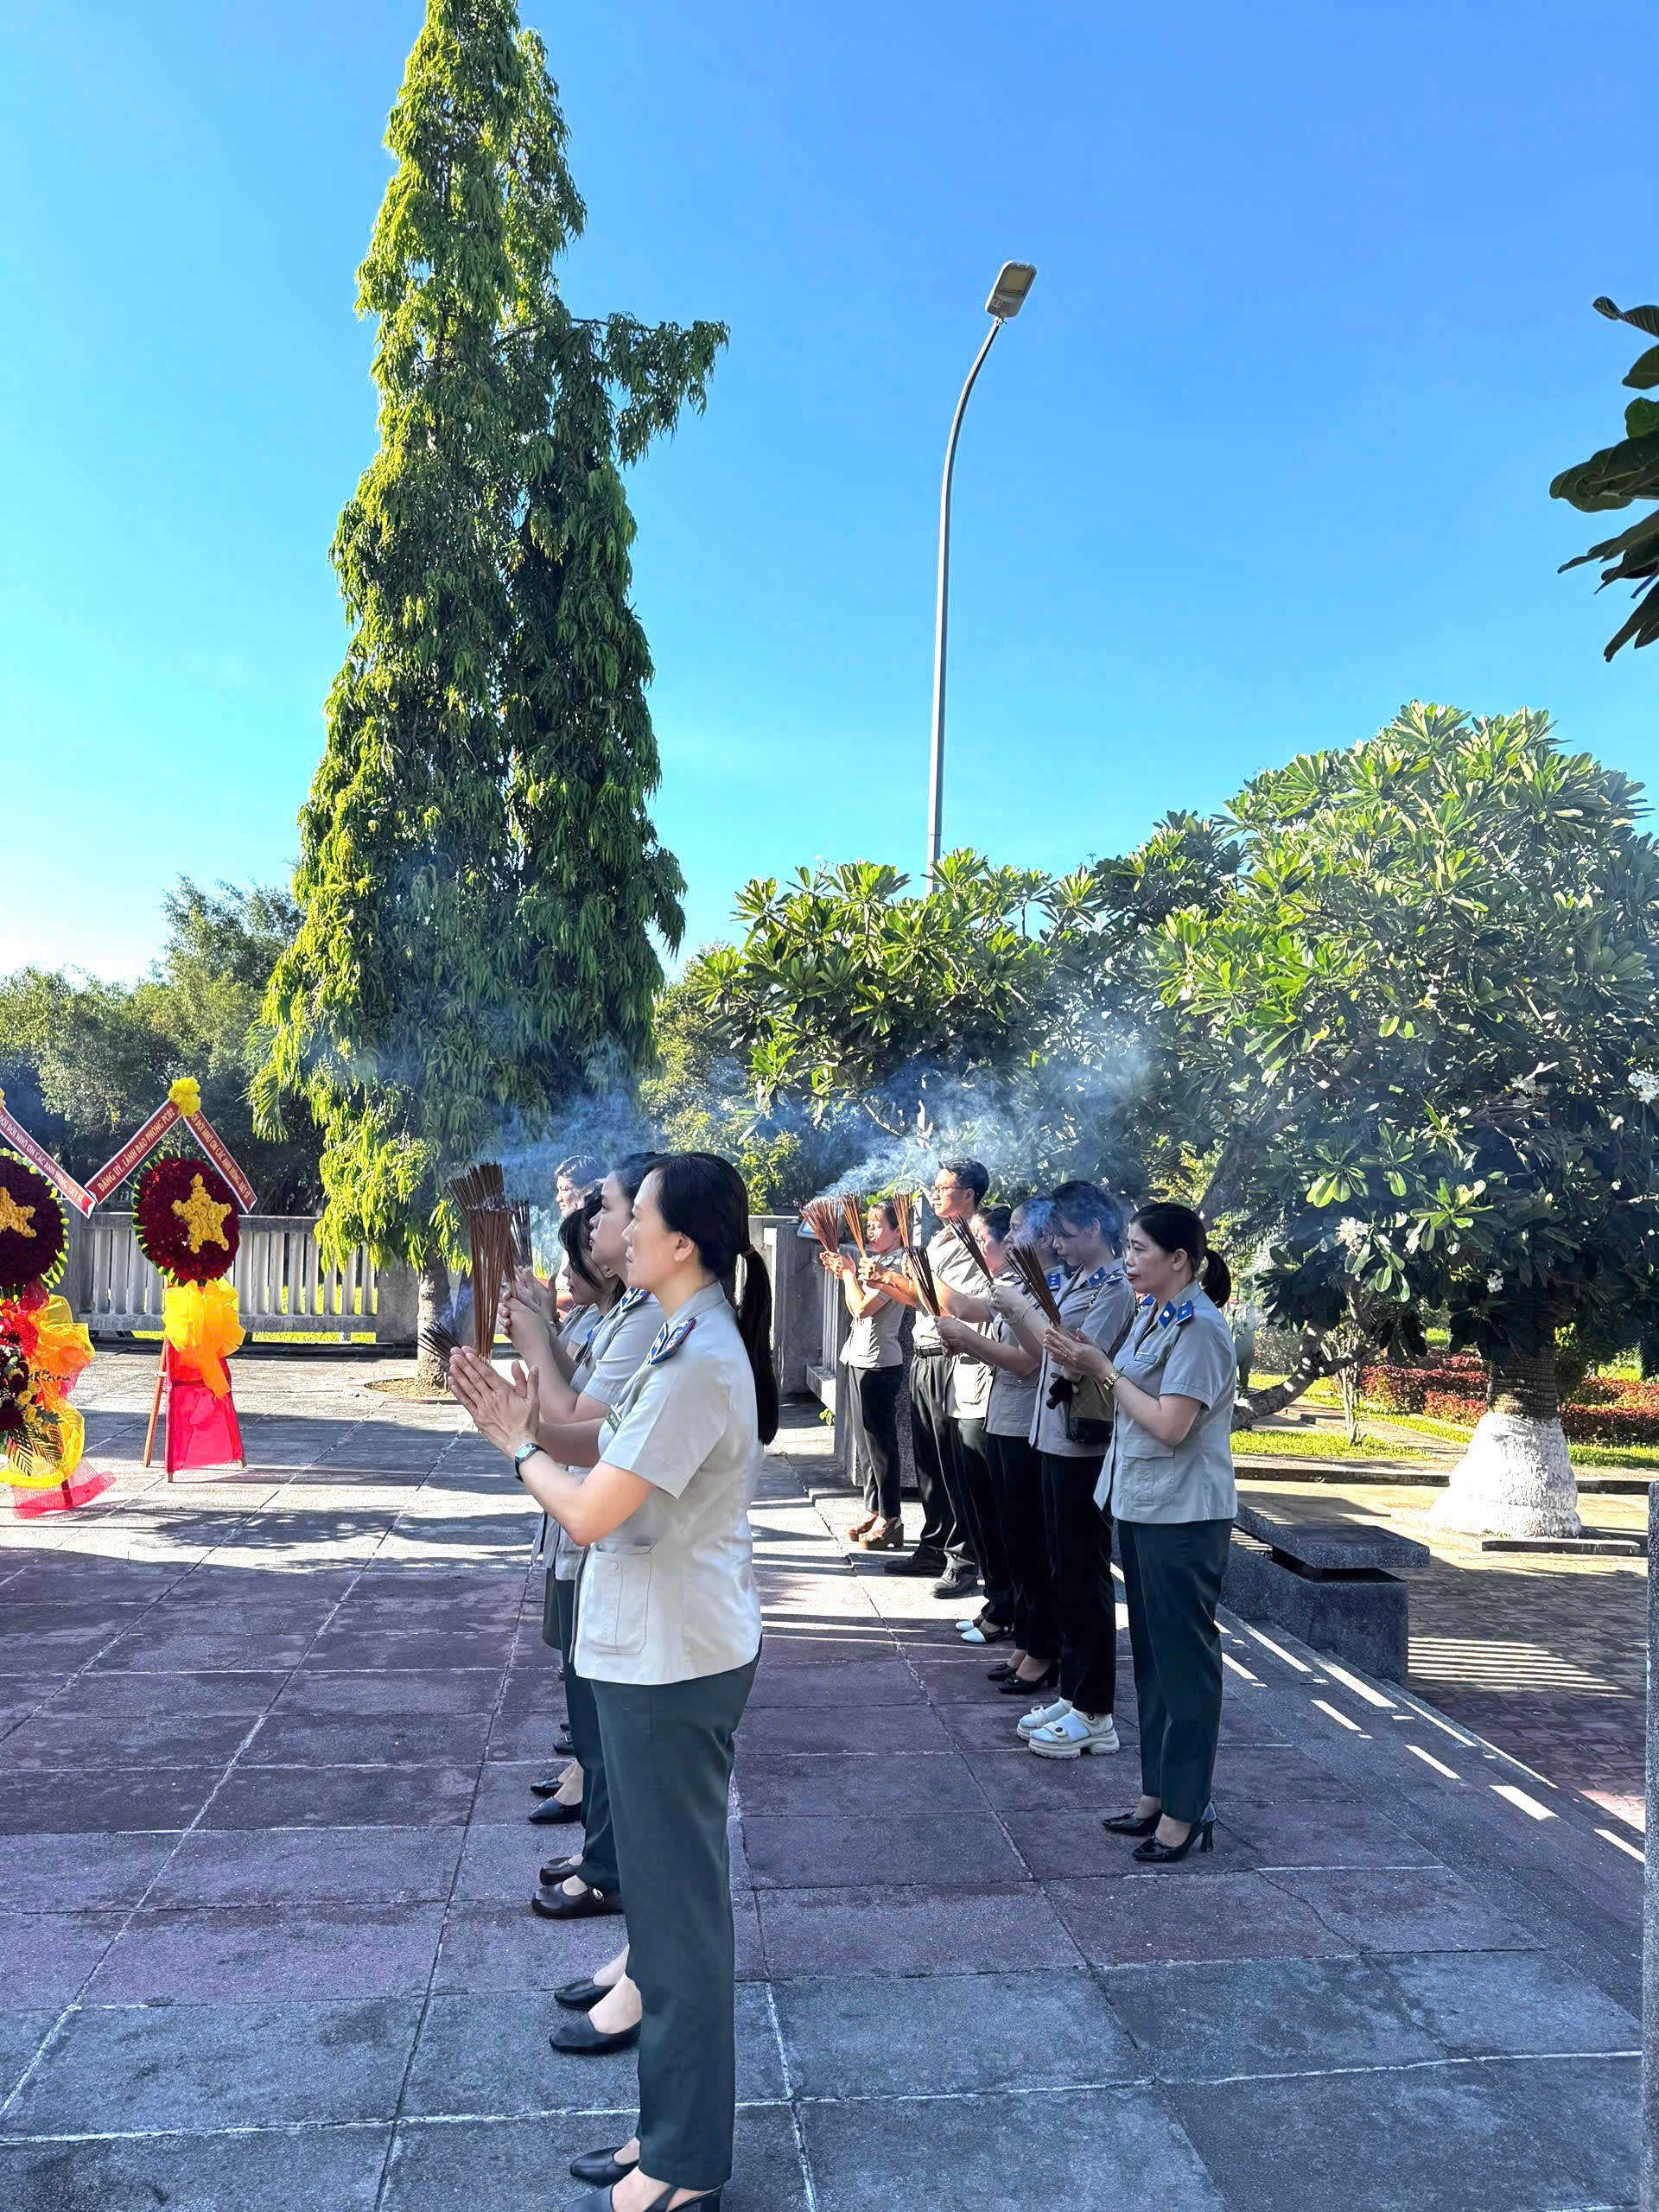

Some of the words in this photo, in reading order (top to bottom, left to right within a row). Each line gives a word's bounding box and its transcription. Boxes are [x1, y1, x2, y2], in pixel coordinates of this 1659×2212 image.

[97, 1171, 116, 1192] ĐẢNG
[122, 1148, 138, 1166] LÃNH
[135, 1137, 149, 1154] ĐẠO
[145, 1119, 164, 1142] PHÒNG
[161, 1107, 175, 1125] PC02
[215, 1147, 226, 1161] CÁC
[221, 1158, 232, 1171] ANH
[35, 1152, 46, 1166] CÁC
[44, 1161, 55, 1175] ANH
